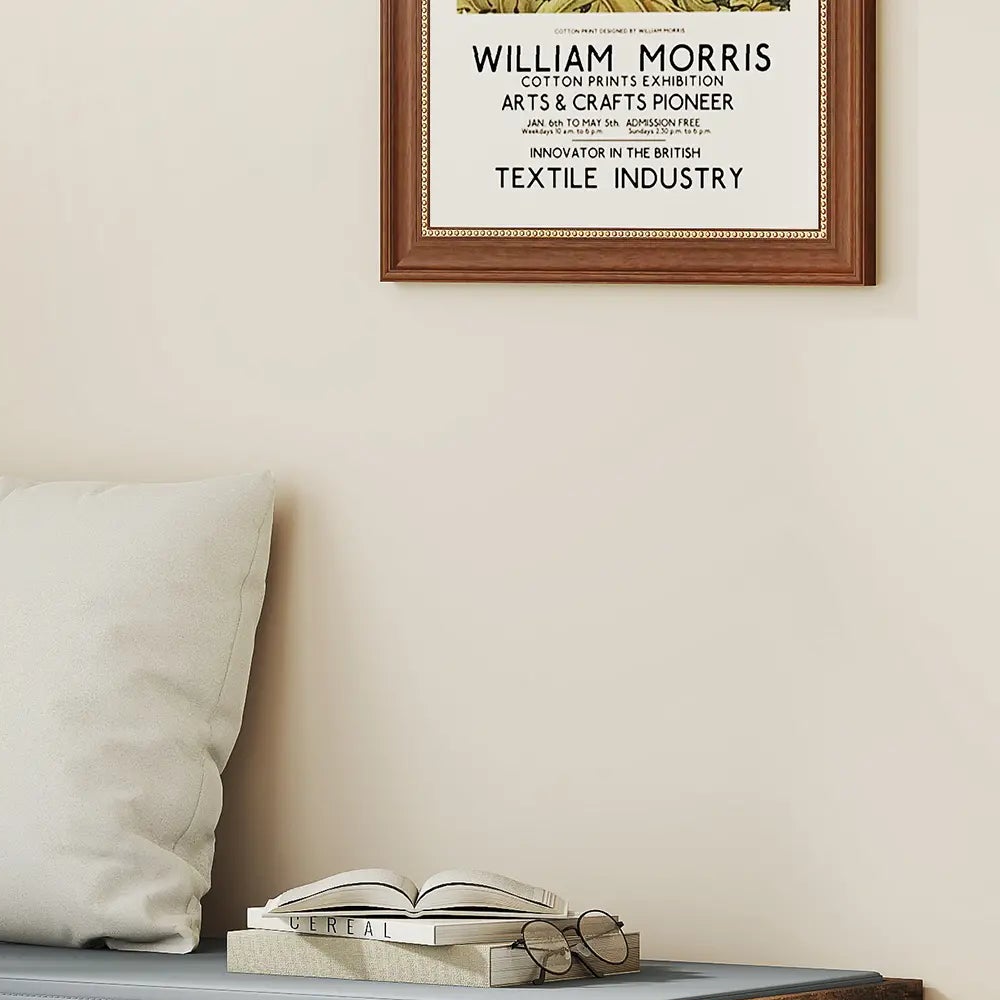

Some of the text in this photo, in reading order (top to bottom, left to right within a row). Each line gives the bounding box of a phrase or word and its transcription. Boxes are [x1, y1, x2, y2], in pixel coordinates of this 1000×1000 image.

[472, 43, 772, 73] WILLIAM MORRIS
[520, 75, 724, 88] COTTON PRINTS EXHIBITION
[501, 92, 735, 112] ARTS & CRAFTS PIONEER
[548, 118, 564, 128] 6th
[567, 118, 581, 128] TO
[581, 118, 602, 128] MAY
[626, 118, 677, 128] ADMISSION
[678, 118, 701, 128] FREE
[529, 147, 701, 160] INNOVATOR IN THE BRITISH
[494, 167, 744, 190] TEXTILE INDUSTRY
[290, 916, 391, 939] CEREAL
